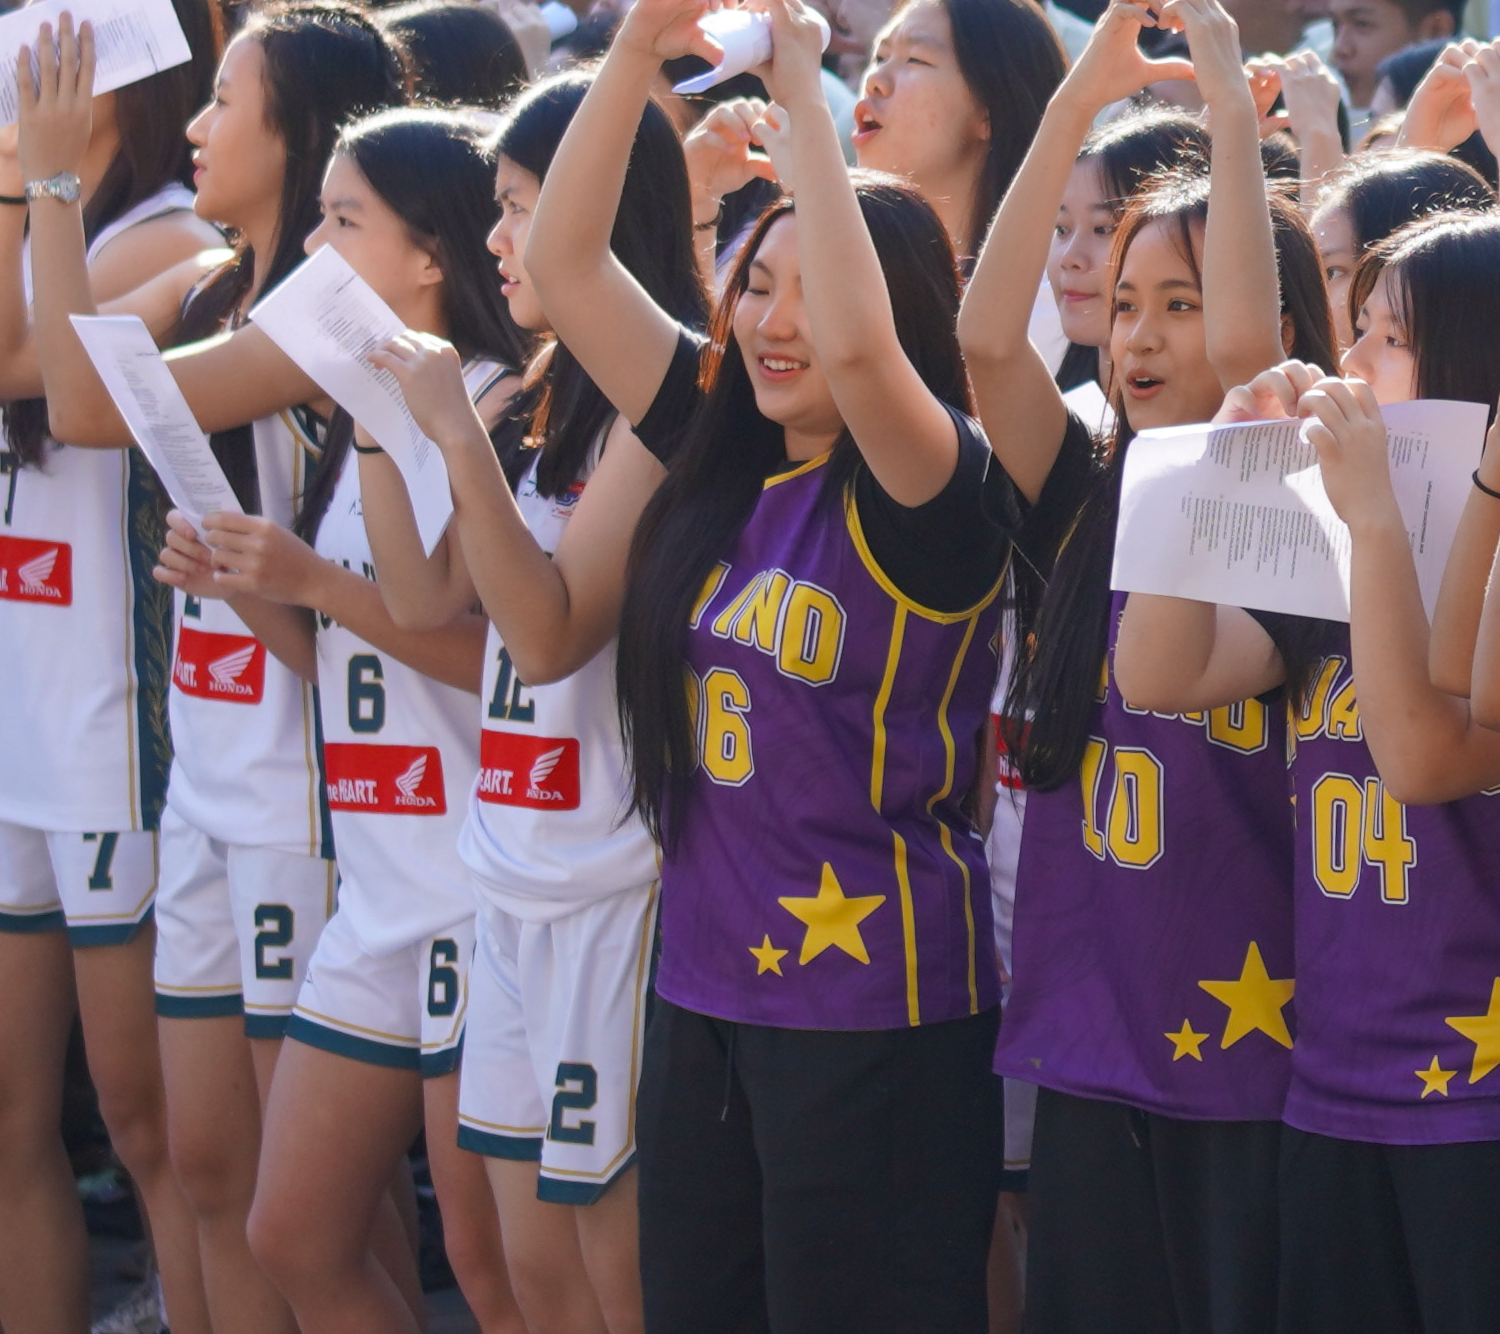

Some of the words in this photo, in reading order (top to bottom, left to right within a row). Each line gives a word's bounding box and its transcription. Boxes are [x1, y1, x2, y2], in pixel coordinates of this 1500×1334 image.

[0, 450, 22, 527] 7
[19, 583, 63, 598] HONDA
[709, 567, 848, 689] IND
[208, 680, 255, 696] HONDA
[347, 652, 386, 735] 6
[1286, 653, 1364, 770] UA
[327, 782, 338, 801] ne
[479, 768, 515, 797] EART.
[1080, 734, 1165, 871] 10
[82, 831, 120, 892] 7
[1311, 771, 1418, 906] 04
[254, 903, 296, 981] 2
[427, 938, 460, 1019] 6
[547, 1062, 599, 1148] 2
